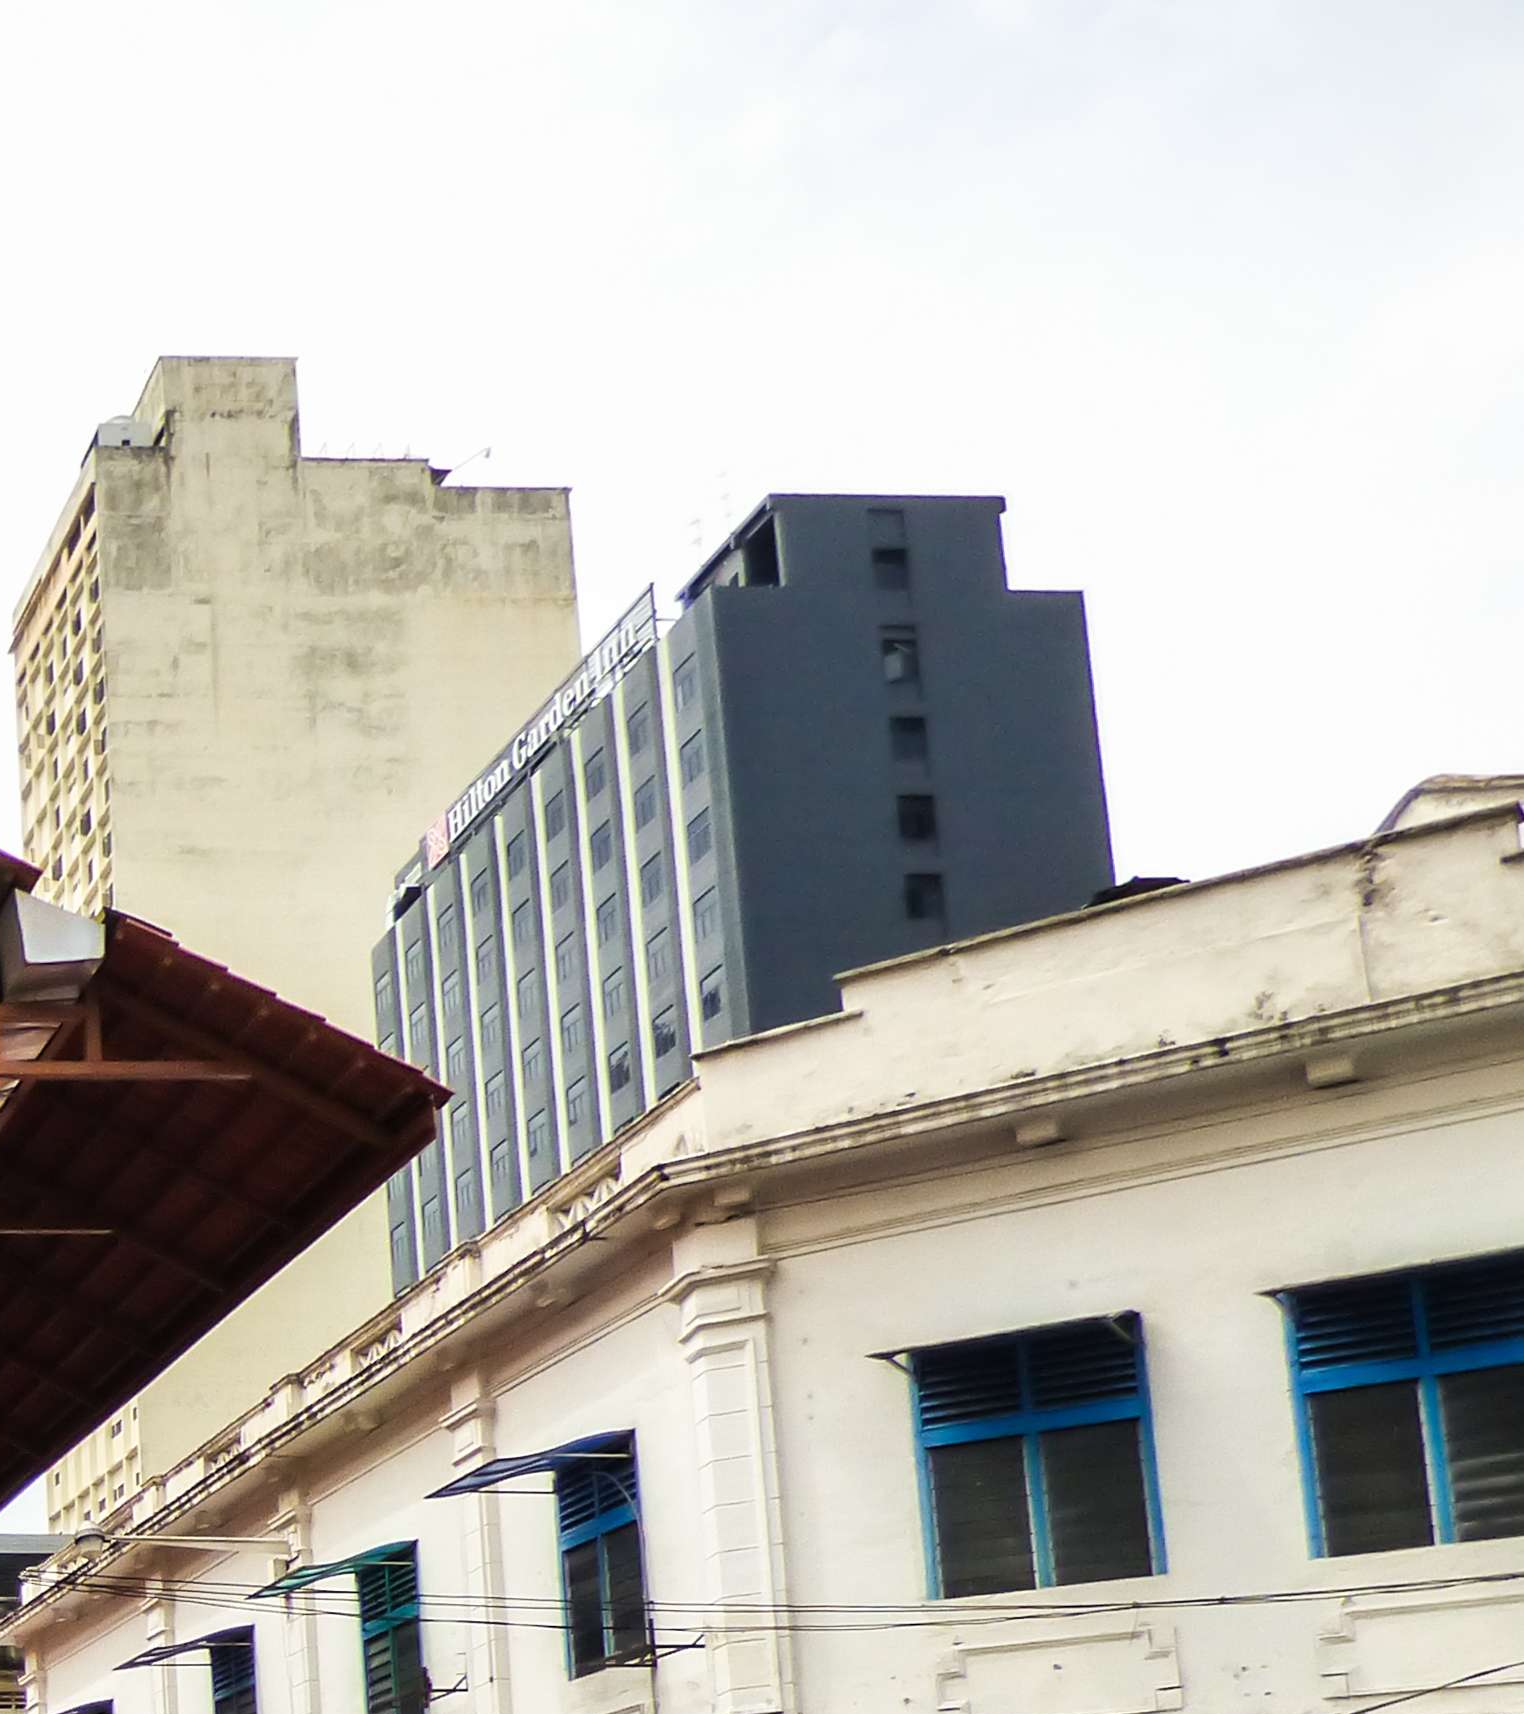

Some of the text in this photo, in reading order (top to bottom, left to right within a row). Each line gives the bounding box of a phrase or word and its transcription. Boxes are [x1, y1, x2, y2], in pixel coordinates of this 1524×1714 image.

[447, 625, 638, 842] Hilton Garden Inn
